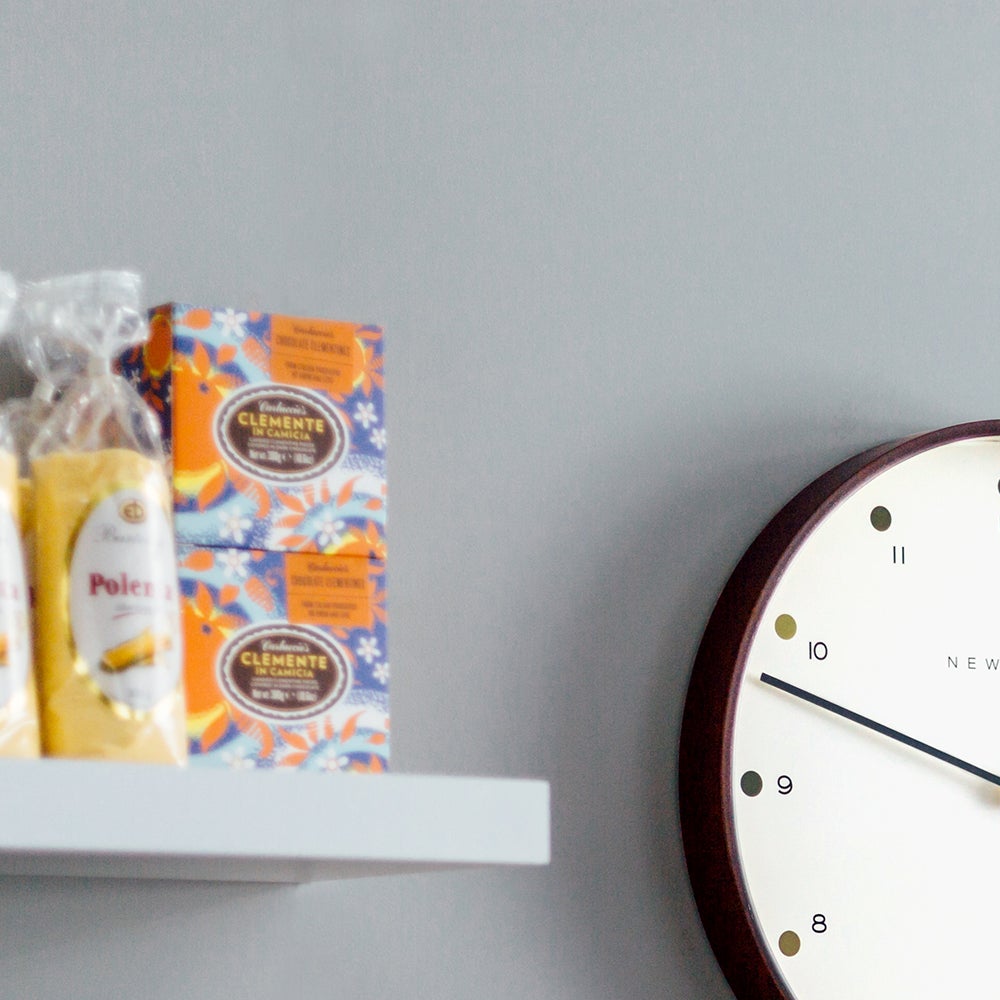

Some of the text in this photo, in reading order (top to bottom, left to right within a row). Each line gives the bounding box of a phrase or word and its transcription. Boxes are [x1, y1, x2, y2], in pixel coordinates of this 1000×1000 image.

[238, 411, 325, 433] CLEMENTE
[252, 426, 311, 441] IN CAMICIA
[893, 546, 904, 564] 11
[89, 572, 173, 601] Polena
[241, 651, 327, 670] CLEMENTE
[809, 642, 828, 660] 10
[255, 666, 314, 679] IN CAMICIA
[777, 775, 793, 795] 9
[812, 914, 827, 933] 8
